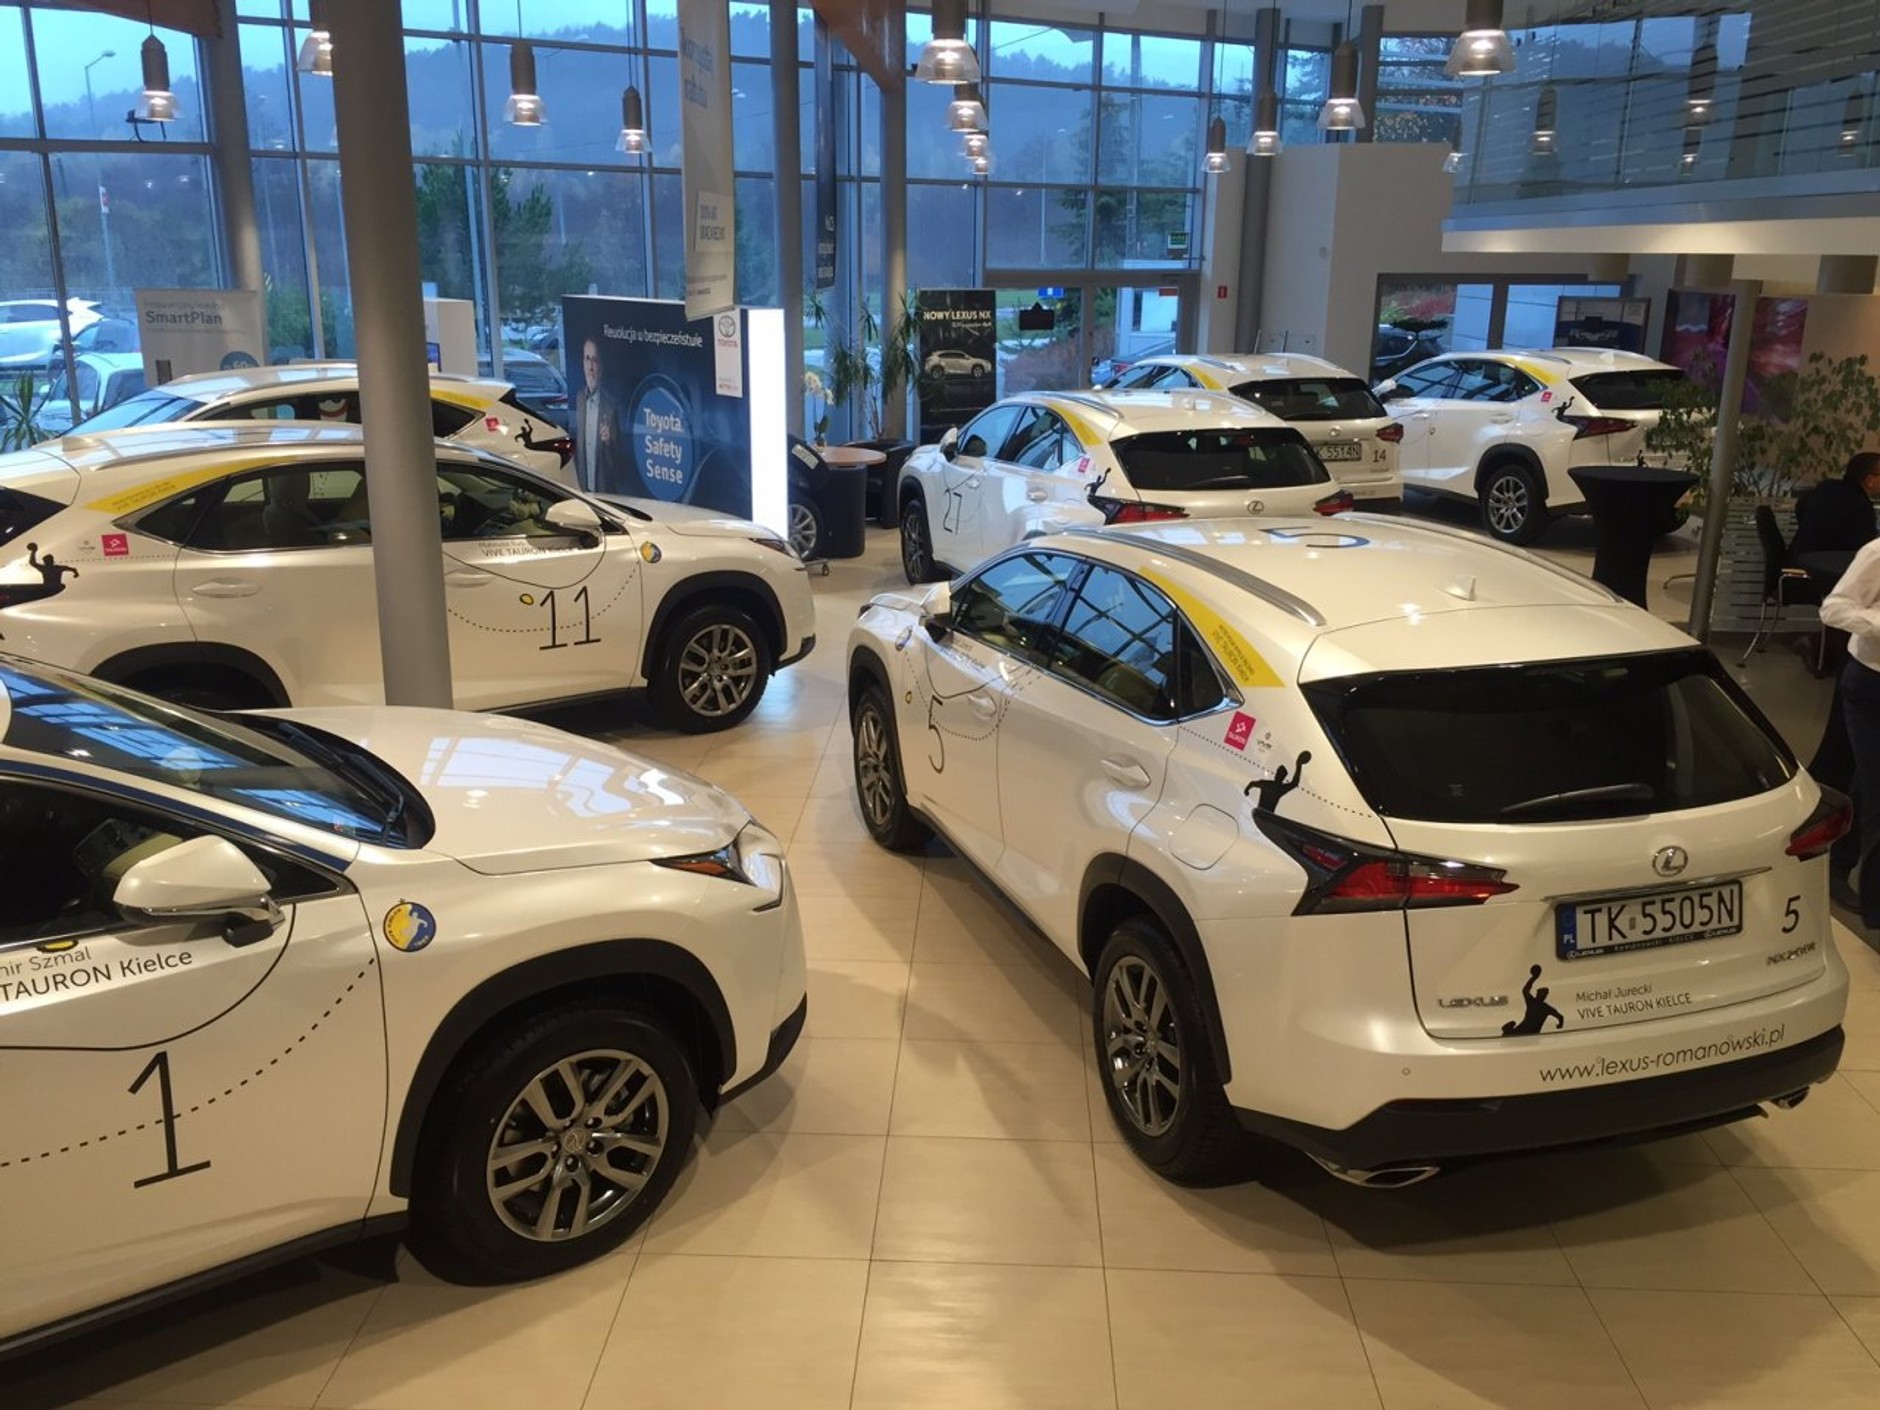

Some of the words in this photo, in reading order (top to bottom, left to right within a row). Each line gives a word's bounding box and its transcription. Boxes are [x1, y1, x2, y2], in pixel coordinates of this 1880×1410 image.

[145, 310, 223, 325] SmartPlan
[923, 310, 950, 320] NOWY
[951, 310, 978, 320] LEXUS
[979, 310, 991, 319] NX
[643, 407, 682, 433] Toyota
[645, 434, 683, 464] Safety
[1372, 448, 1387, 463] 14
[646, 458, 683, 484] Sense
[943, 487, 963, 536] 27
[481, 548, 504, 557] VIVE
[507, 546, 546, 556] TAURON
[539, 585, 602, 651] 11
[928, 694, 945, 775] 5
[1583, 904, 1629, 943] TK
[1640, 888, 1735, 936] 5505N
[1781, 894, 1802, 935] 5
[1563, 934, 1576, 945] PL
[29, 946, 92, 972] Szmal
[0, 963, 112, 1002] TAURON
[119, 951, 193, 977] Kielce
[1576, 987, 1612, 1003] Michał
[1613, 982, 1653, 999] Jurecki
[1577, 1006, 1604, 1020] VIVE
[1607, 999, 1654, 1016] TAURON
[1656, 992, 1692, 1009] KIELCE
[1539, 1024, 1786, 1083] www.lexus-romanowski.pl
[127, 1050, 212, 1190] 1
